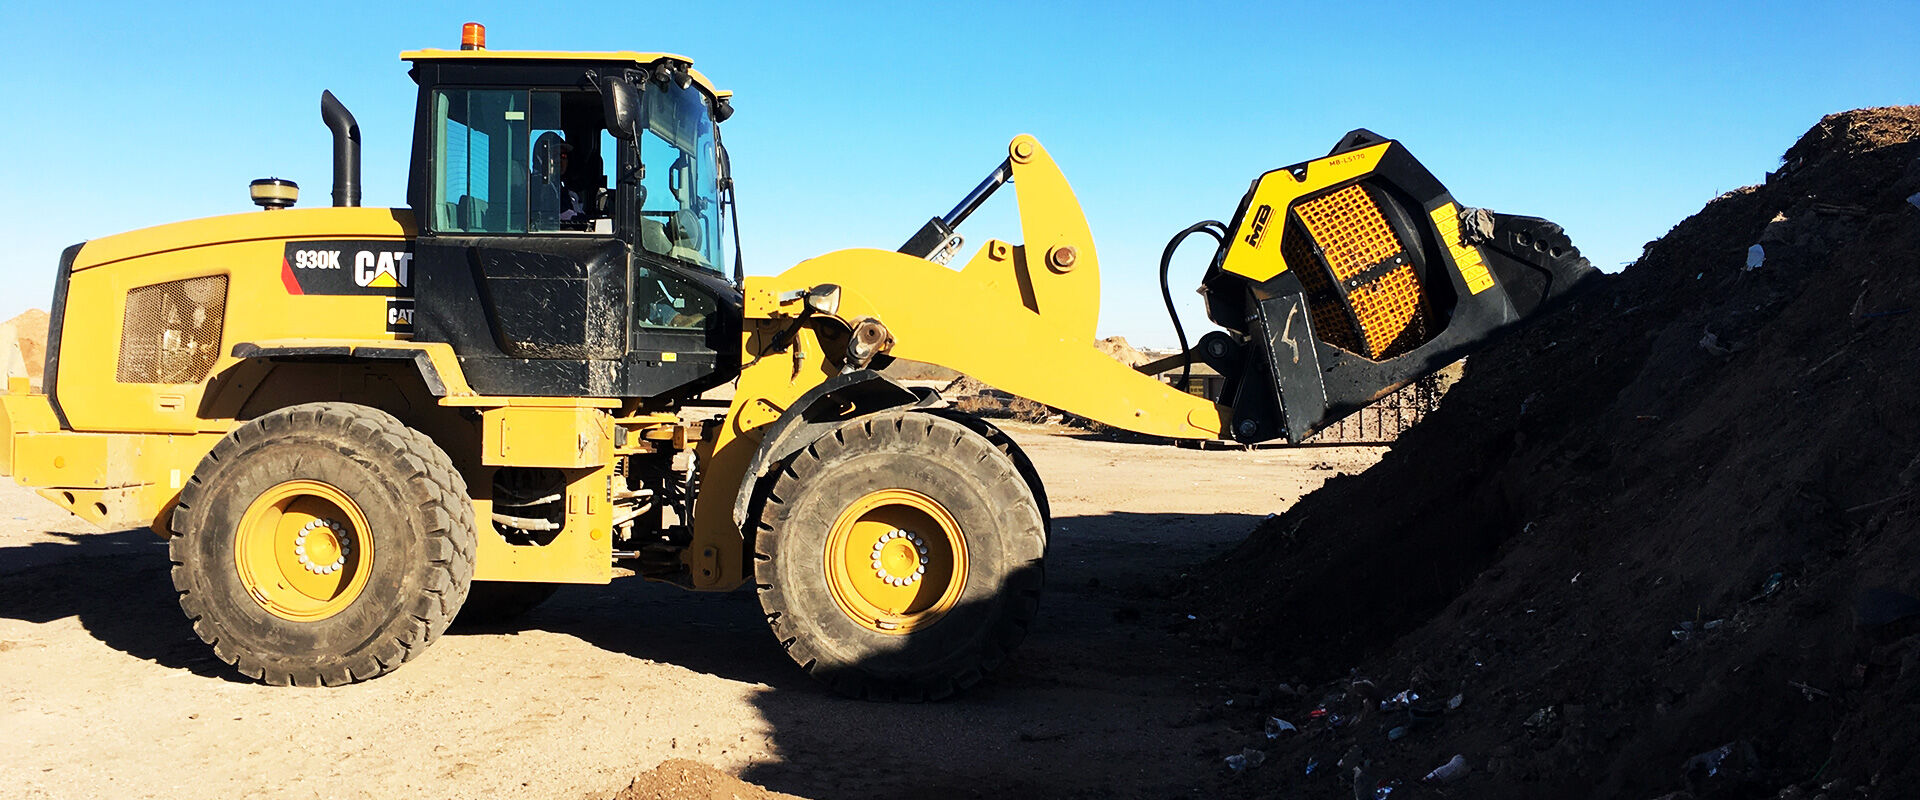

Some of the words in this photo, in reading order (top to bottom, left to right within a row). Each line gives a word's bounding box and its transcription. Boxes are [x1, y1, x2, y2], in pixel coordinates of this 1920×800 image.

[1329, 153, 1366, 167] MB-LS170
[1245, 204, 1272, 248] MB
[295, 249, 340, 269] 930K
[354, 250, 413, 287] CAT
[388, 307, 414, 325] CAT
